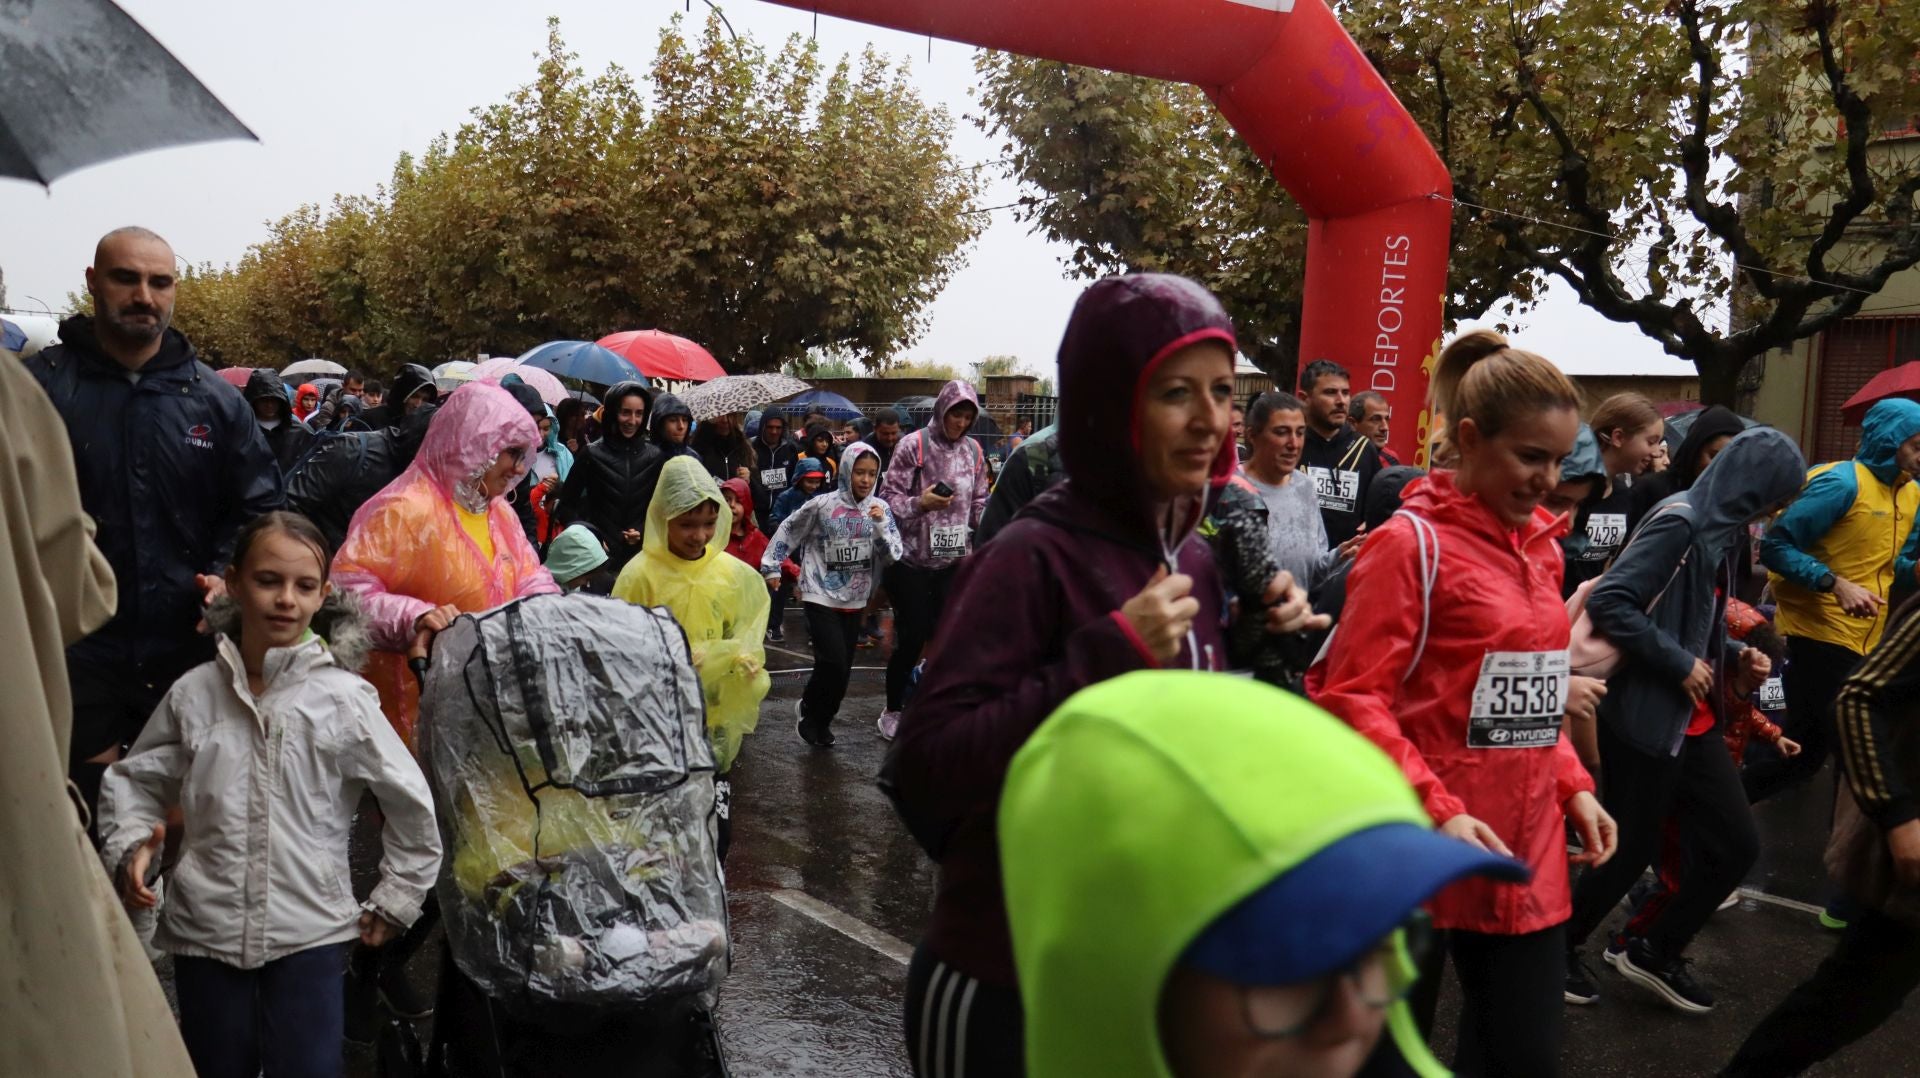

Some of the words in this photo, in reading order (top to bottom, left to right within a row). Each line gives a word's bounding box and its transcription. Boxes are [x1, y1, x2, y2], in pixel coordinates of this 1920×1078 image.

[1371, 235, 1410, 391] DEPORTES
[765, 473, 784, 483] 3850
[1316, 477, 1351, 498] 365
[933, 533, 959, 547] 3567
[836, 547, 859, 561] 1197
[1490, 675, 1558, 715] 3538
[1513, 727, 1557, 740] HYUNDAI
